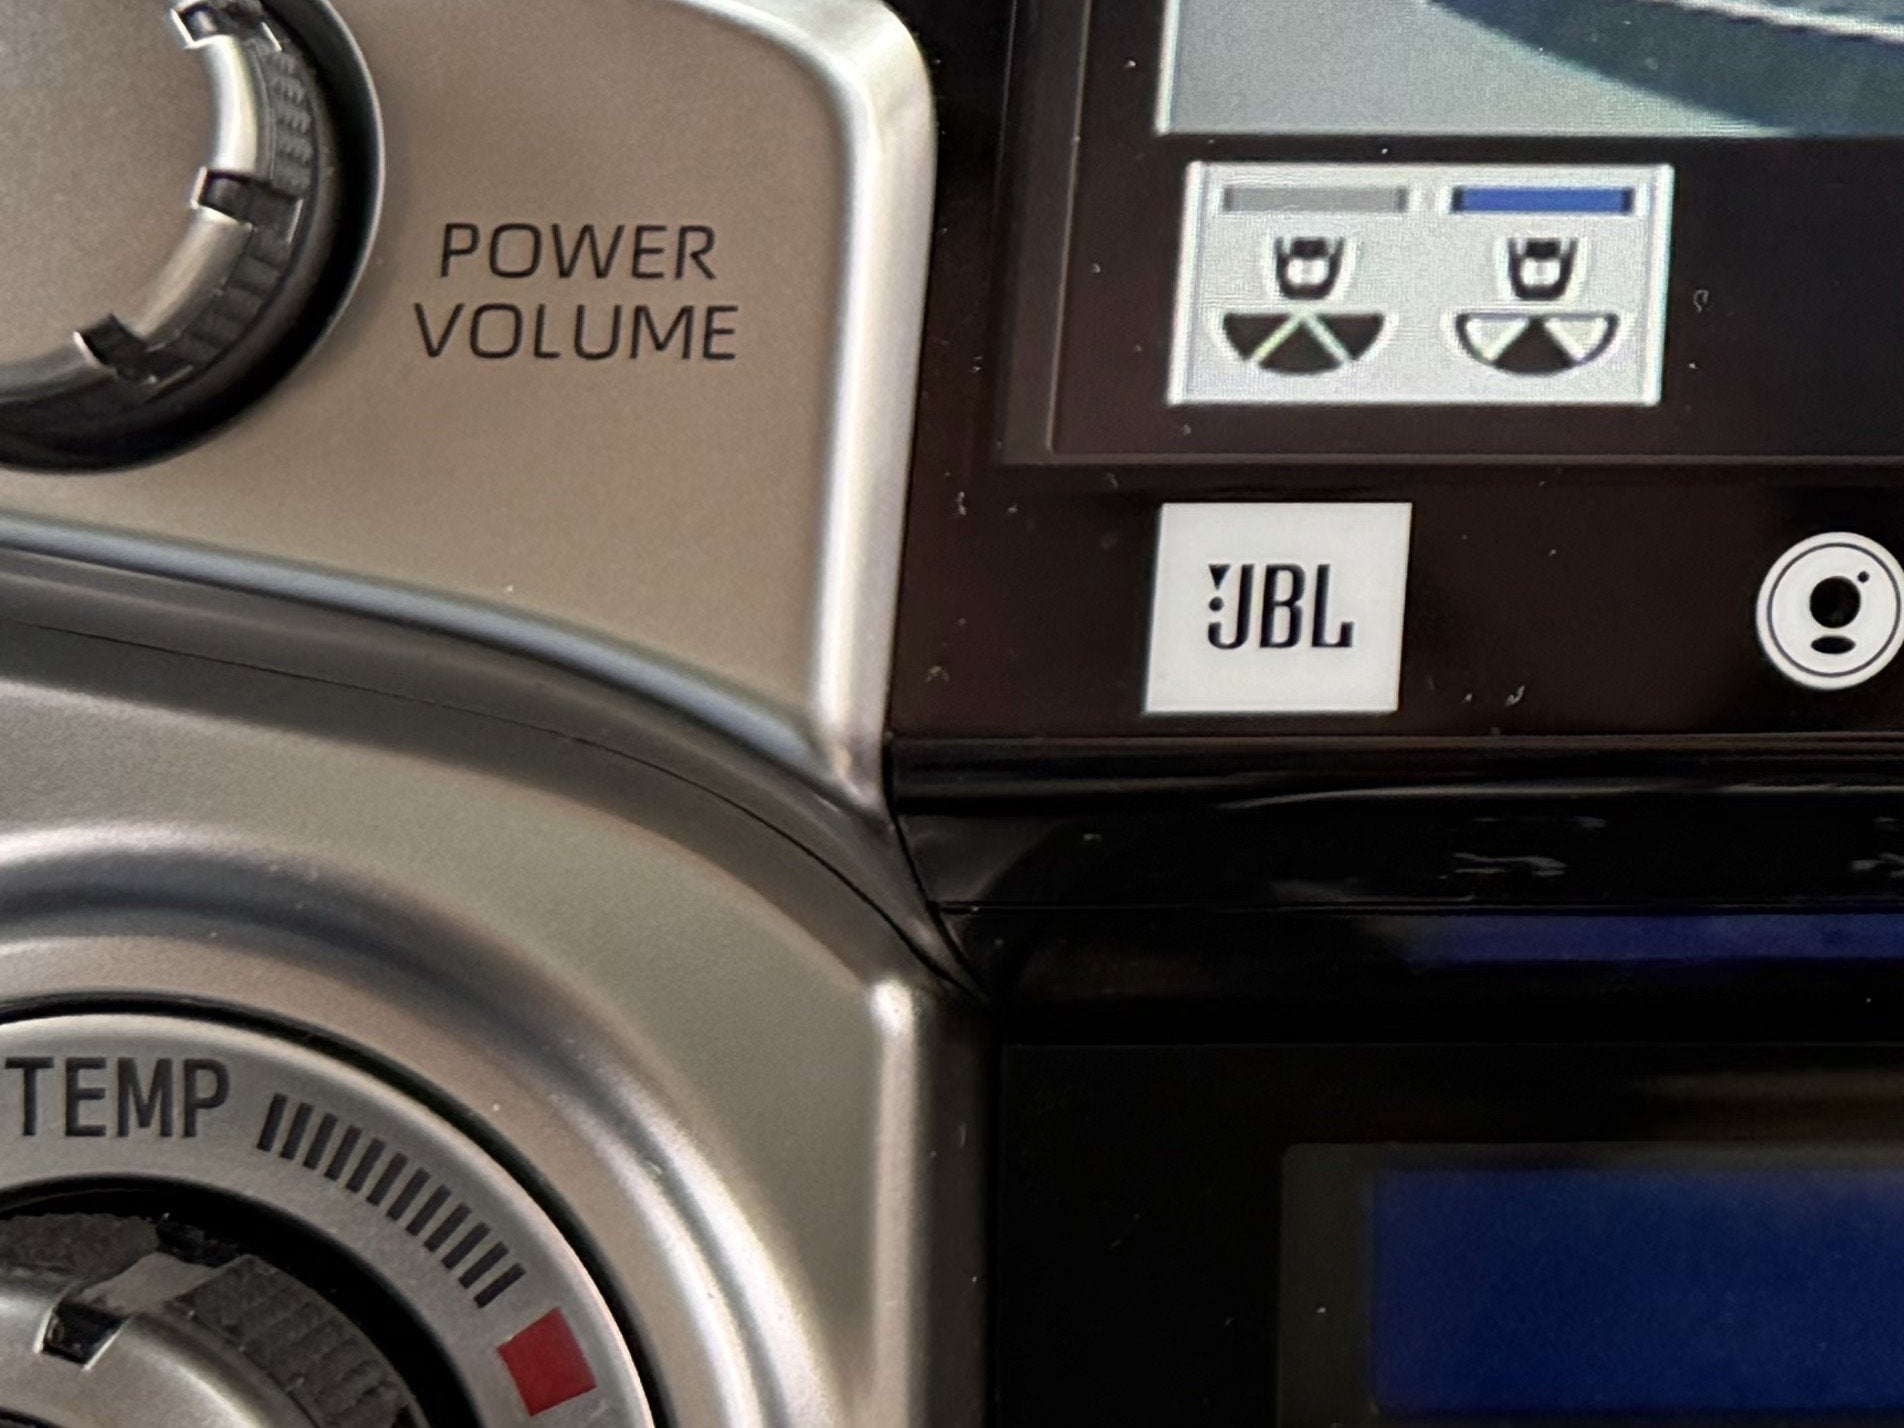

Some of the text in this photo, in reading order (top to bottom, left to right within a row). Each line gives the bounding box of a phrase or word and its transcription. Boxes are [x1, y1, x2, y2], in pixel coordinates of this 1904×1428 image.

[439, 221, 716, 281] POWER
[412, 301, 739, 362] VOLUME
[1206, 563, 1354, 651] JBL
[3, 1056, 231, 1139] TEMP
